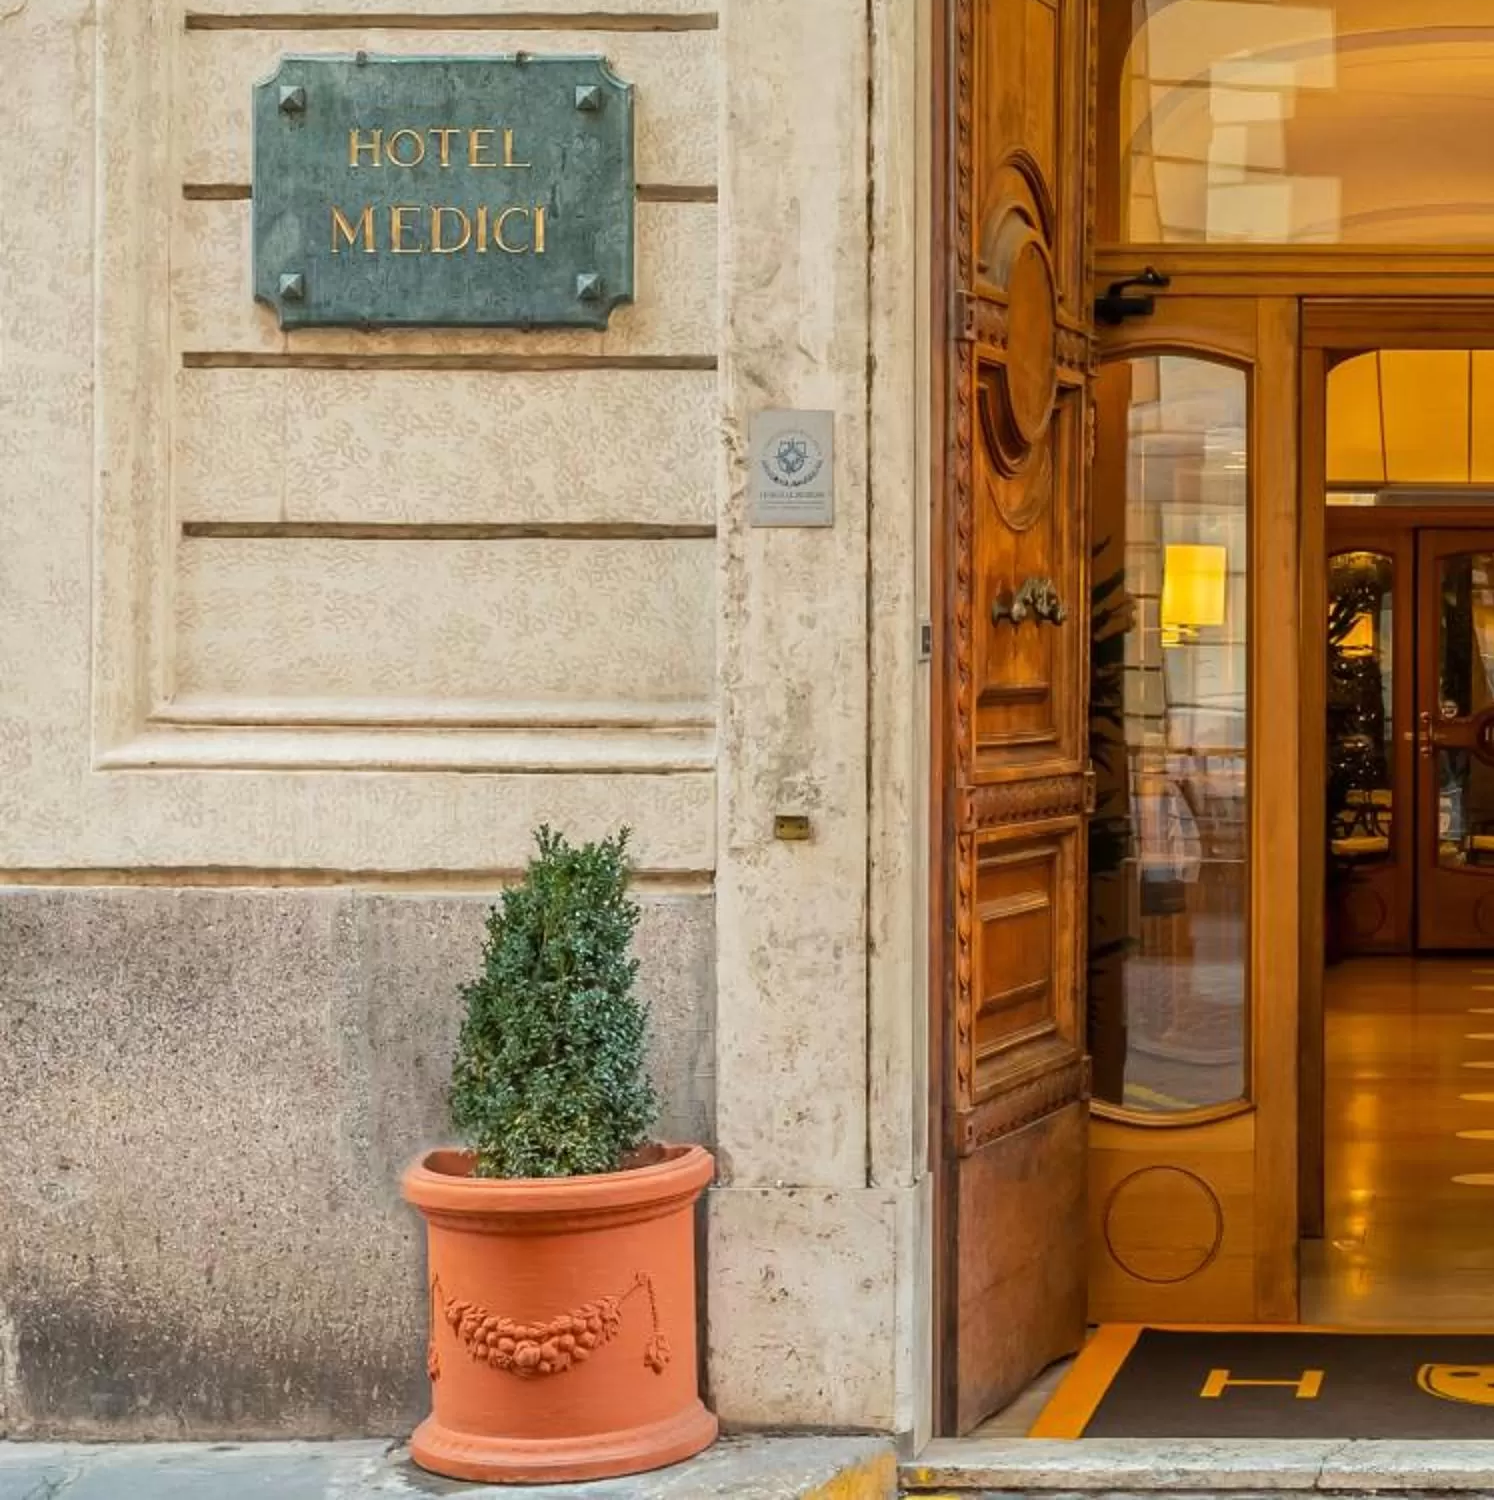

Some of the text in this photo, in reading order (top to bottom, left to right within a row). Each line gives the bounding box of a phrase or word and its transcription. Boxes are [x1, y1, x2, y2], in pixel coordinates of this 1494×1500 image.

[347, 127, 532, 169] HOTEL
[328, 203, 547, 254] MEDICI
[1200, 1368, 1325, 1398] H
